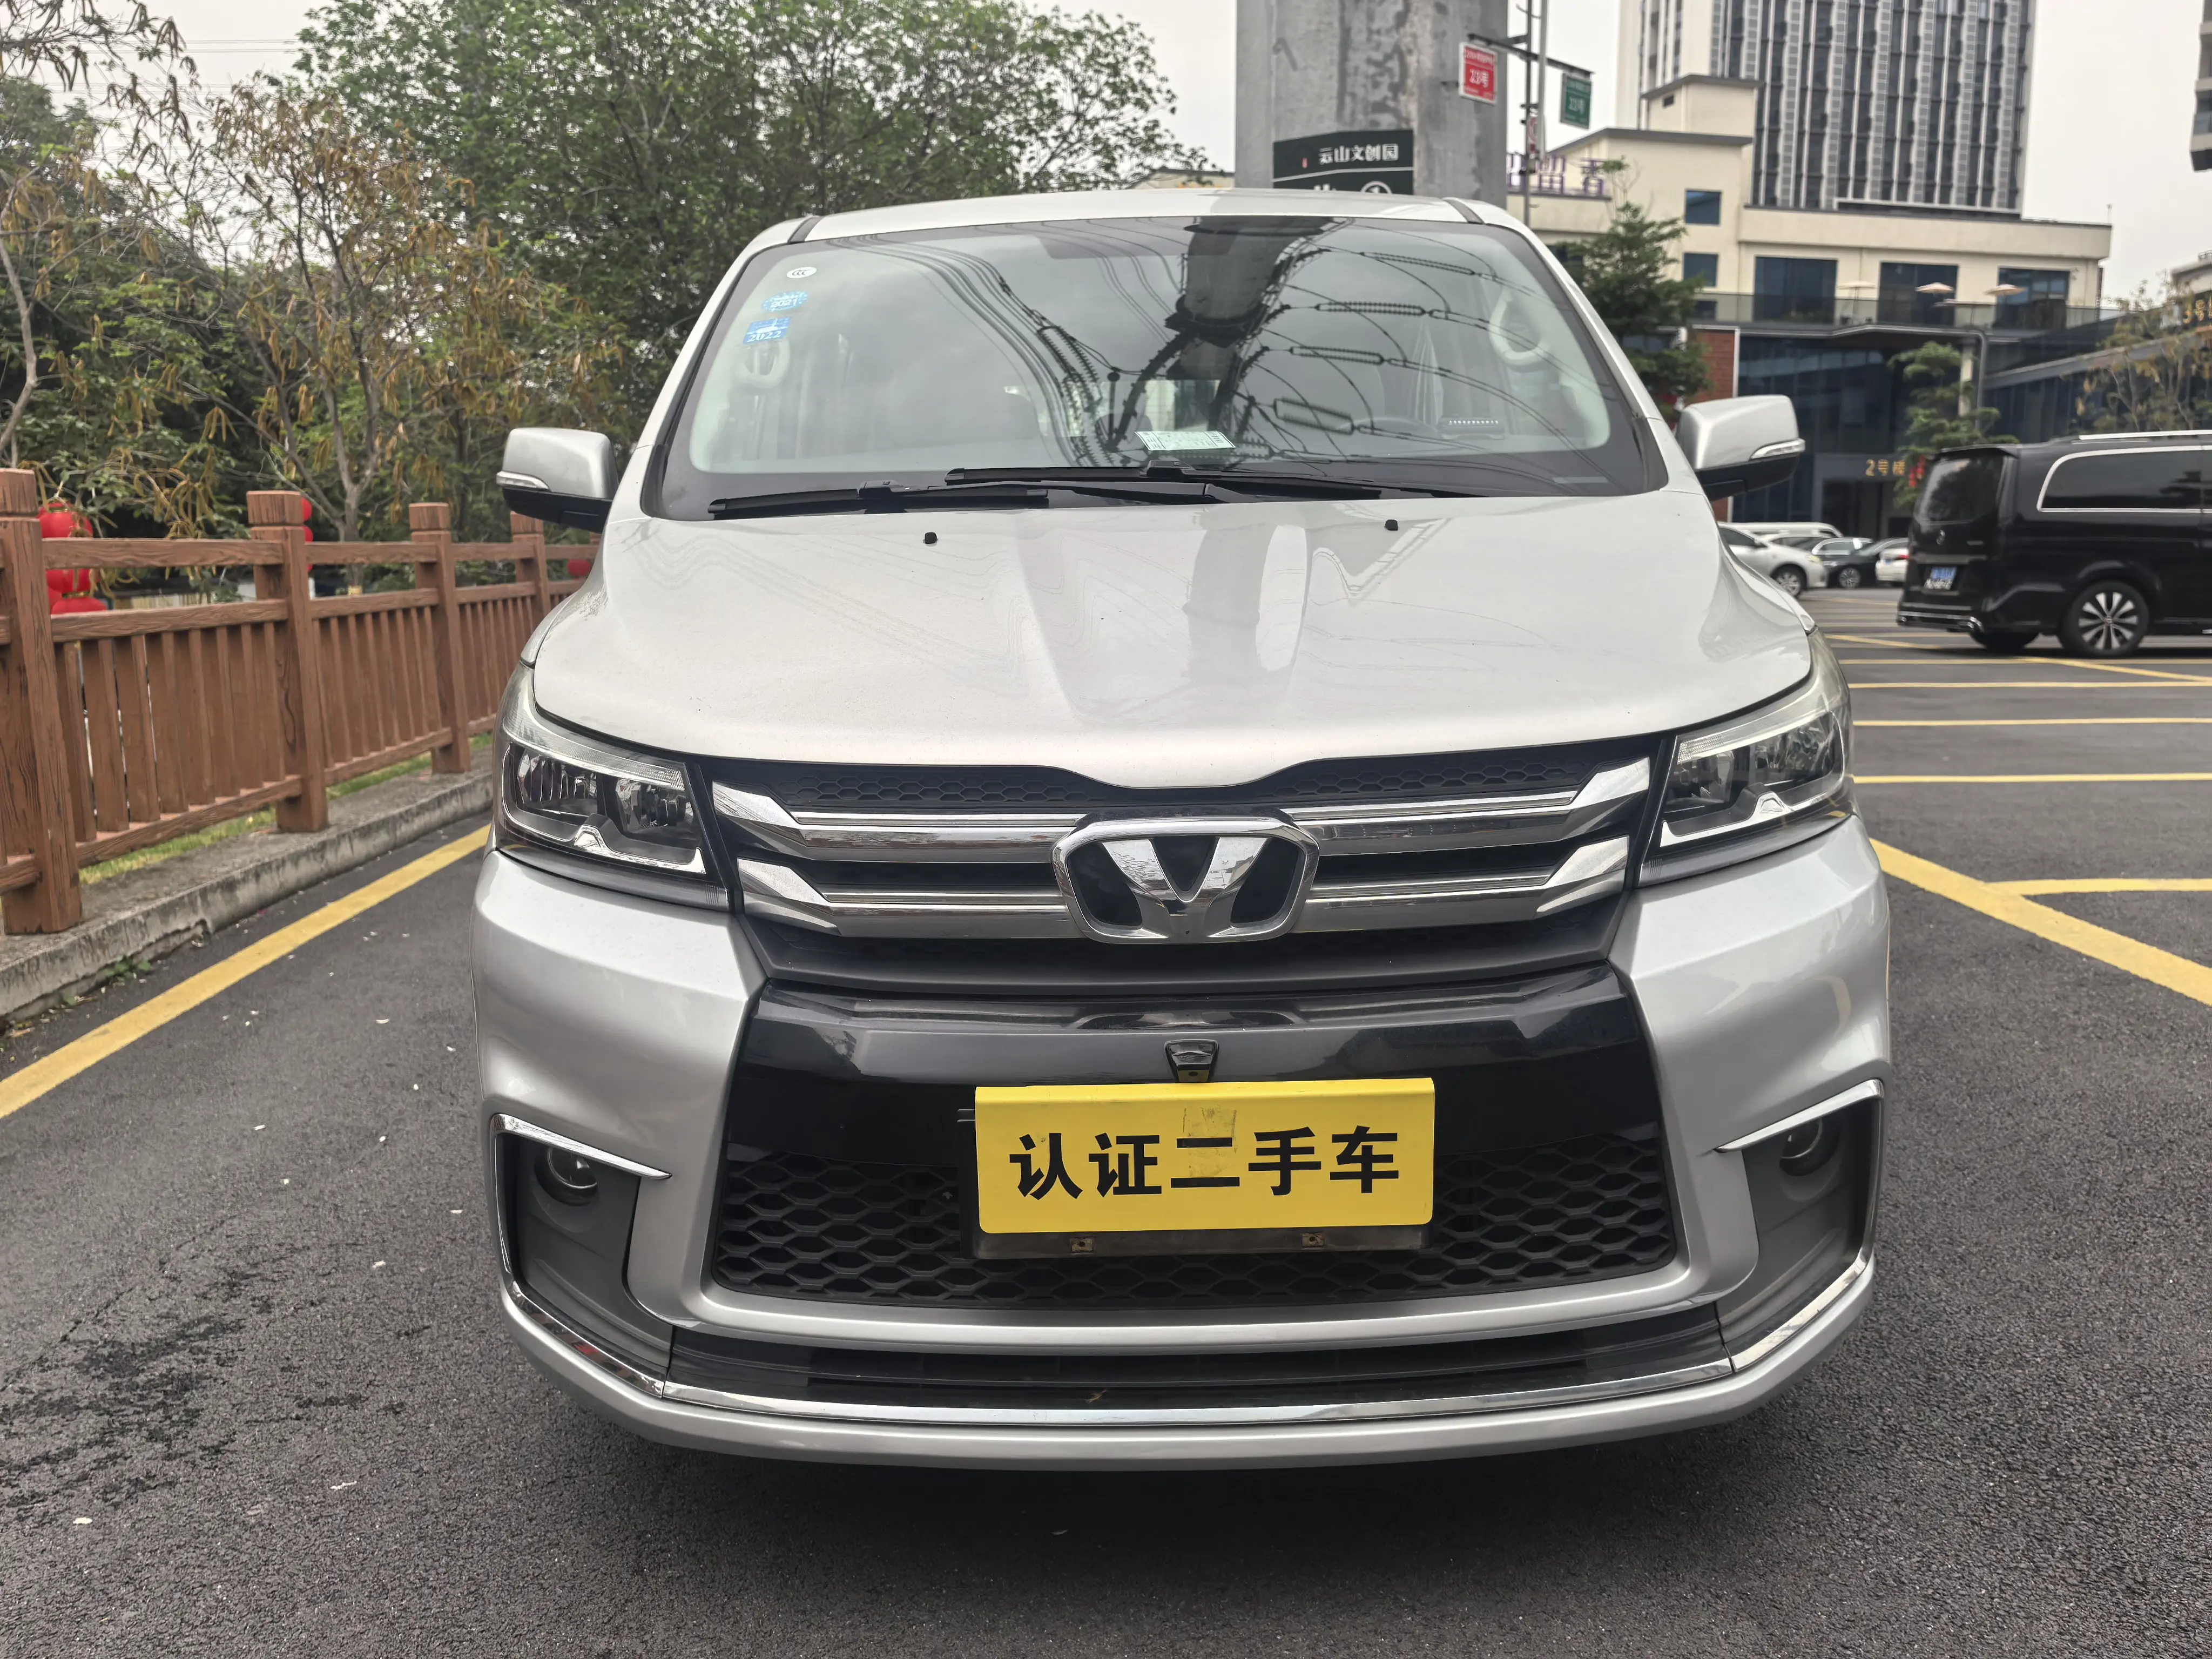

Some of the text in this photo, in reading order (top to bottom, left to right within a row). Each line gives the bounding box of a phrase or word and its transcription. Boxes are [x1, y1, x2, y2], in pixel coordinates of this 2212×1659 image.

[1318, 144, 1399, 165] 云山文创园
[770, 298, 798, 309] 2021
[747, 331, 782, 343] 2022
[1009, 1125, 1399, 1201] 认证二手车
